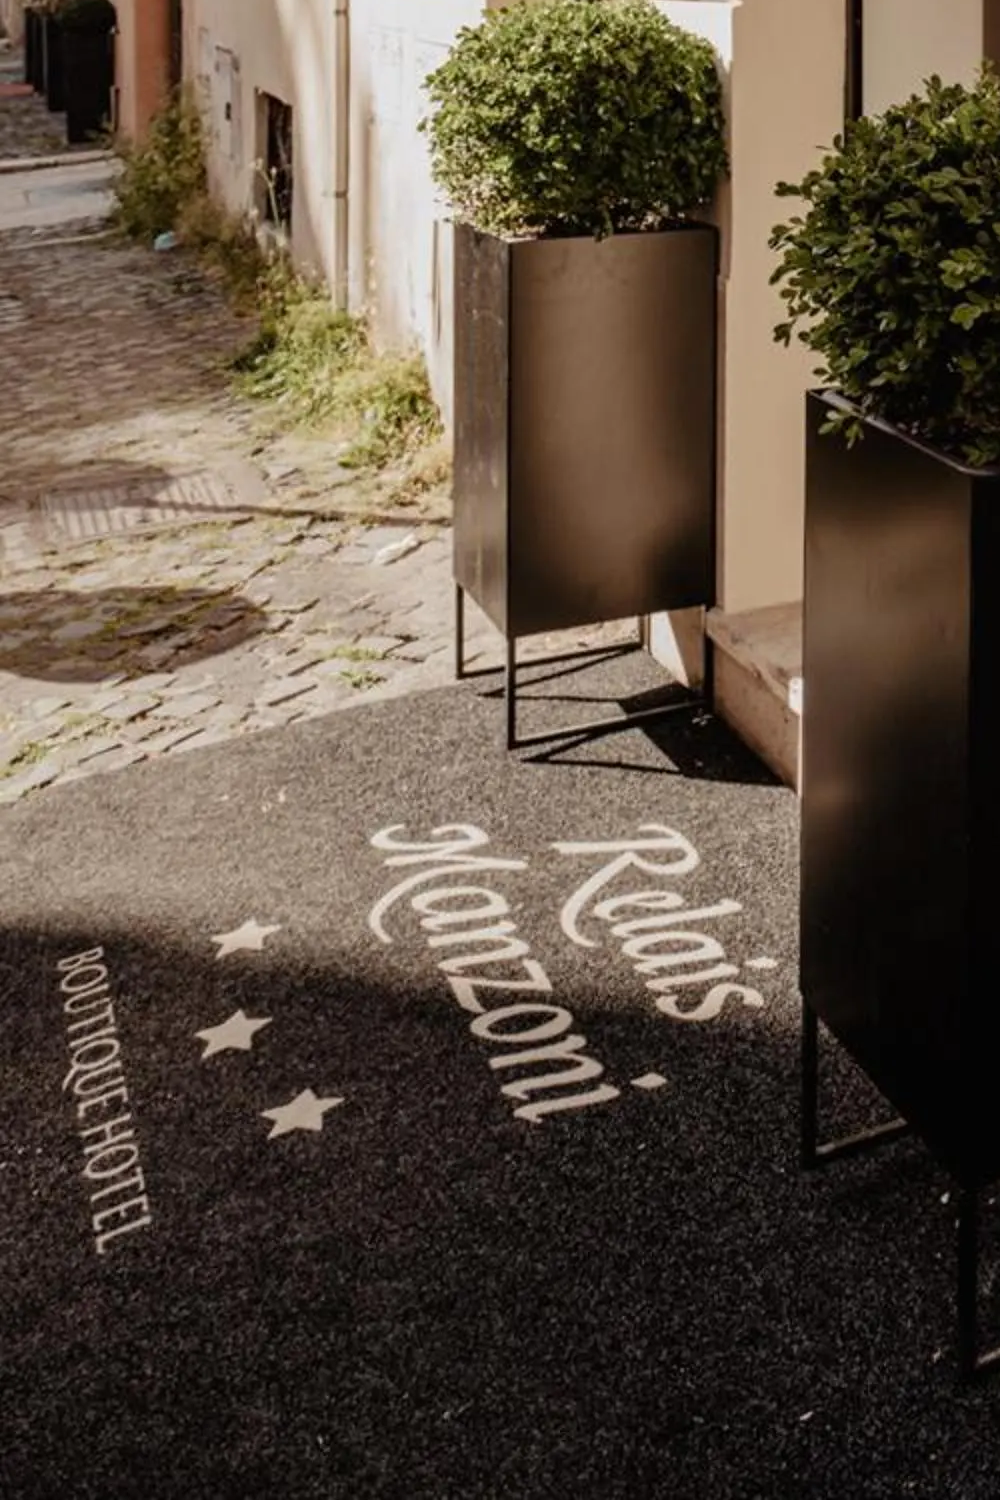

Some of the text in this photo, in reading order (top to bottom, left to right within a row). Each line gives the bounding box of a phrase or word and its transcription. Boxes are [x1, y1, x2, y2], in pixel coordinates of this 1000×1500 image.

[369, 823, 668, 1125] Manzoni
[551, 823, 778, 1022] Relais
[57, 946, 151, 1254] BOUTIQUE HOTEL
